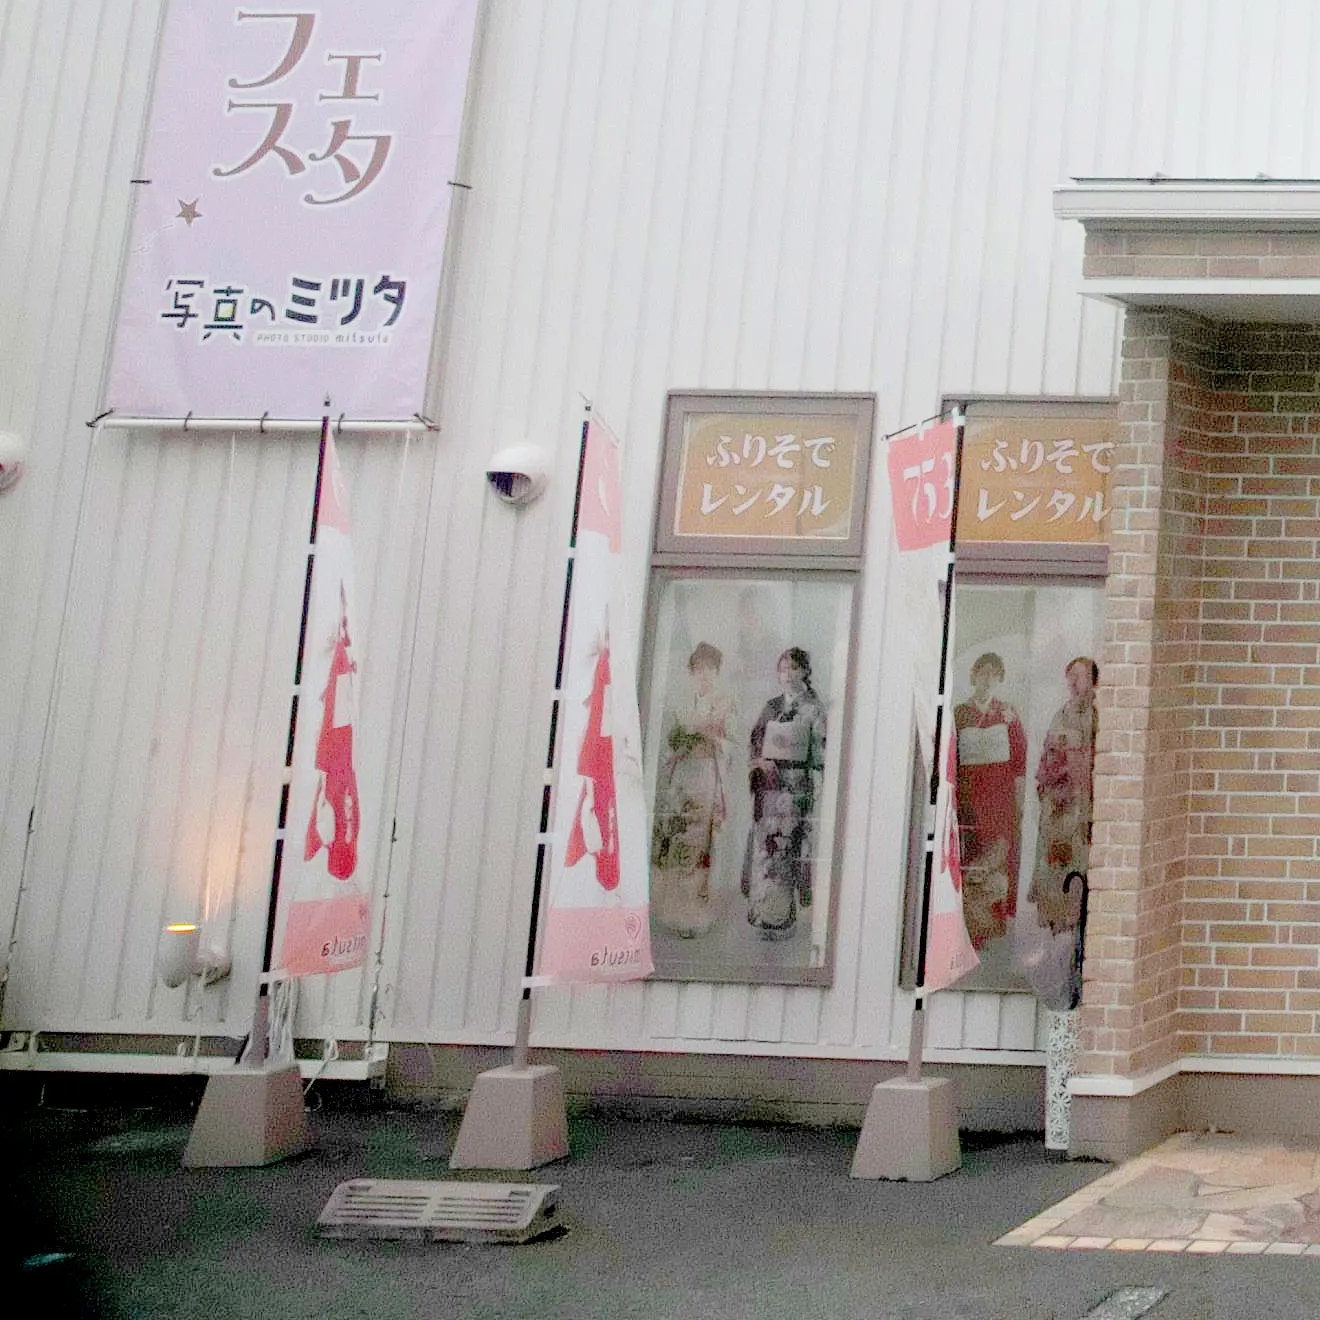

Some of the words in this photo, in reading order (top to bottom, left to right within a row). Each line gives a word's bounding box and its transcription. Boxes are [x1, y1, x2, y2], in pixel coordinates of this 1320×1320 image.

[160, 274, 408, 342] 写真のミツタ
[705, 434, 836, 470] ふりそで
[981, 439, 1116, 473] ふりそで
[699, 483, 831, 520] レンタル
[977, 488, 1112, 523] レンタル
